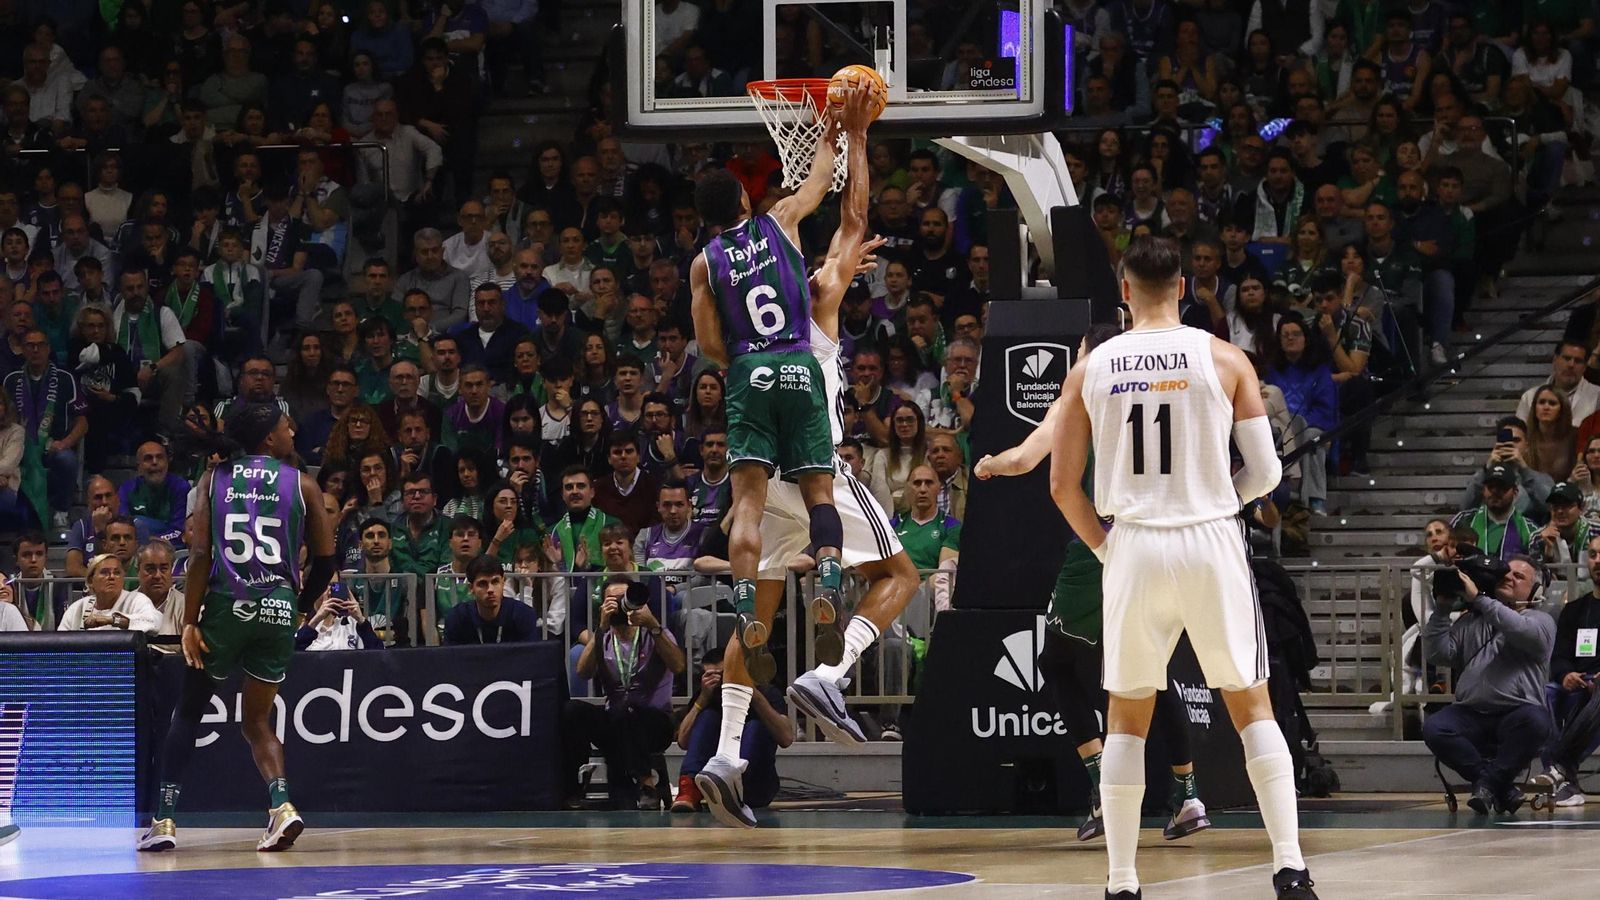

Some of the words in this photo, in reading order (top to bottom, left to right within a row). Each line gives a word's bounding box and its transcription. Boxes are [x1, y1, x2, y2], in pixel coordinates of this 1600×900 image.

[970, 67, 991, 78] liga
[970, 76, 1015, 88] endesa
[724, 236, 769, 263] Taylor
[746, 284, 786, 336] 6
[1110, 353, 1188, 374] HEZONJA
[780, 374, 798, 382] DEL
[1016, 381, 1060, 391] Fundación
[1110, 379, 1189, 396] AUTOHERO
[1022, 392, 1055, 402] Unicaja
[1016, 401, 1053, 409] Balonces
[1126, 403, 1172, 475] 11
[232, 464, 278, 485] Perry
[224, 513, 282, 565] 55
[260, 597, 292, 611] COSTA
[260, 607, 277, 617] DEL
[277, 609, 292, 619] SOL
[258, 615, 291, 627] MÁLAGA
